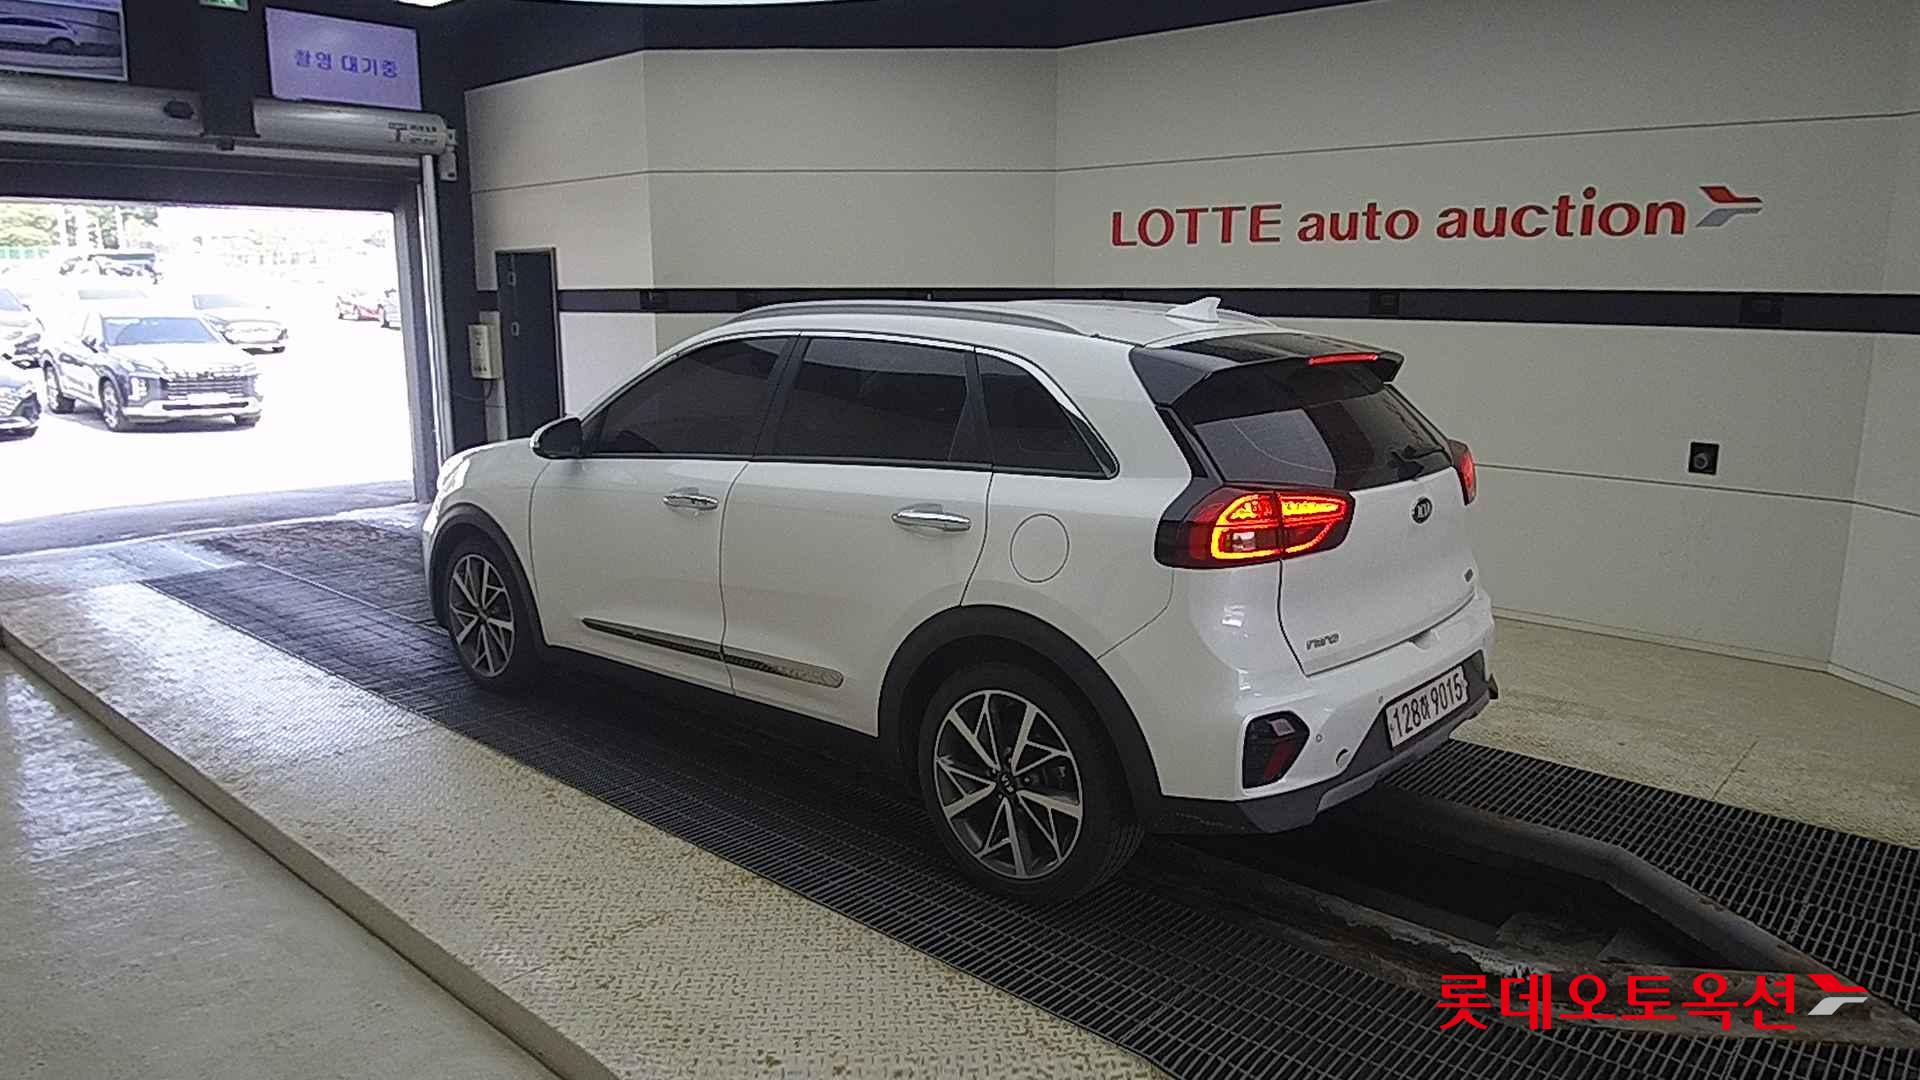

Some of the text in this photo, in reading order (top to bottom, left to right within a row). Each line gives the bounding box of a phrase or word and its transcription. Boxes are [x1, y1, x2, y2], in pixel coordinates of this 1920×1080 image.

[341, 54, 397, 78] 대기중
[1111, 186, 1687, 247] LOTTE auto auction
[1430, 673, 1463, 715] 9015
